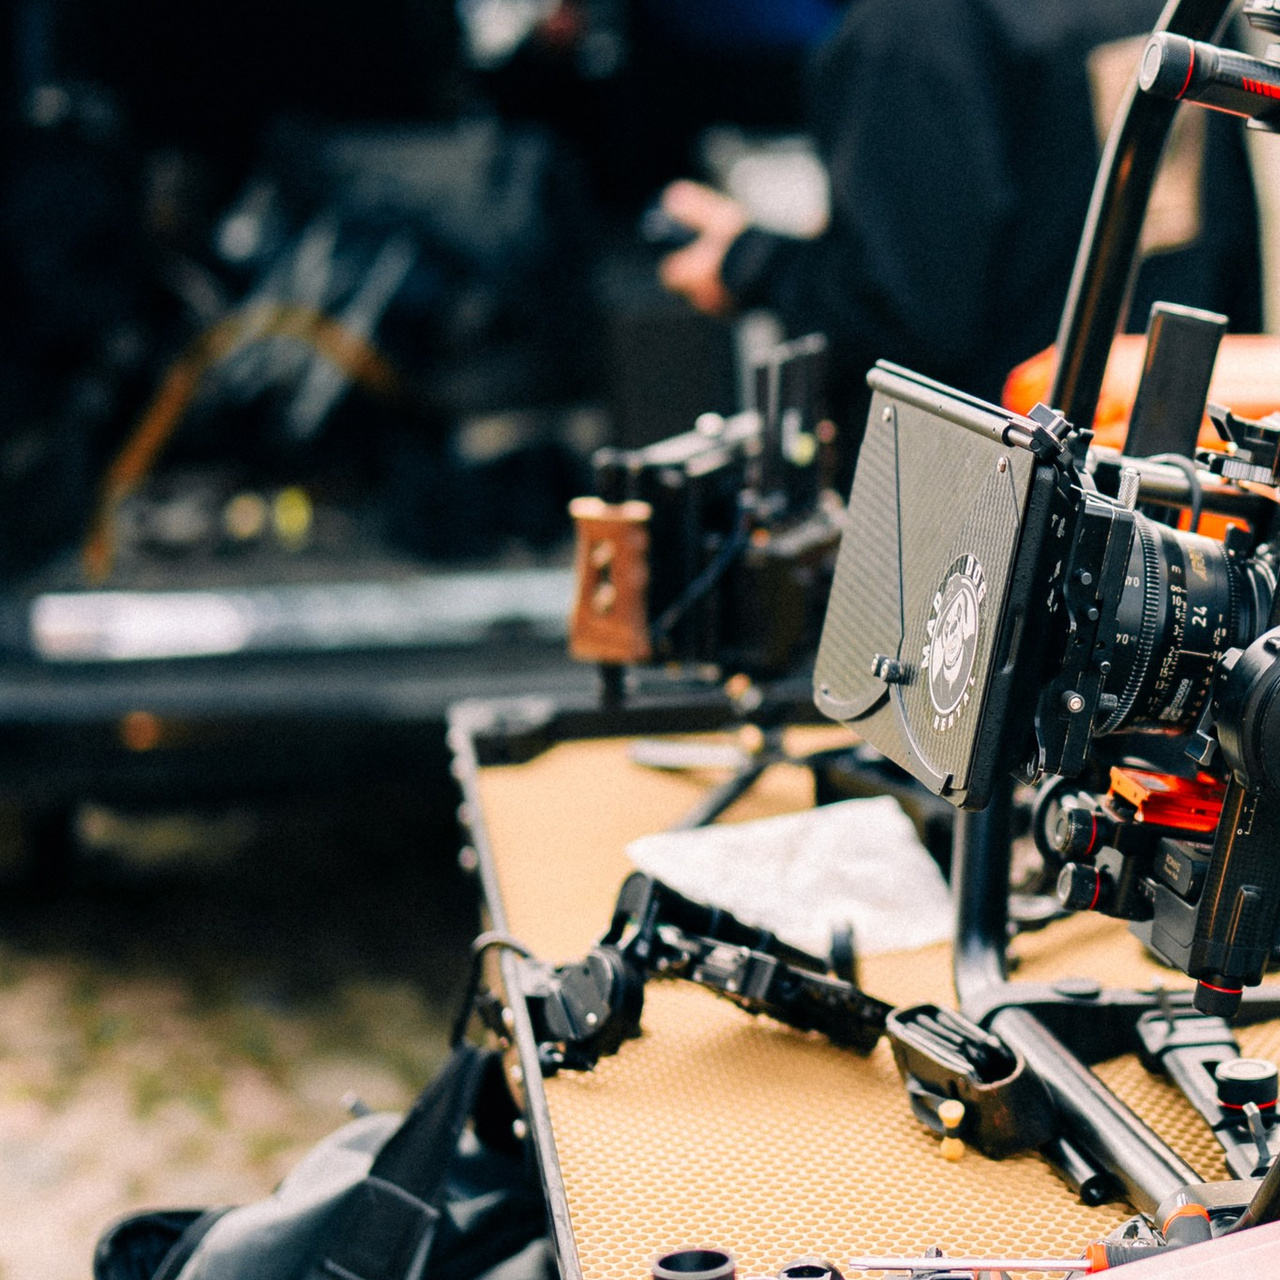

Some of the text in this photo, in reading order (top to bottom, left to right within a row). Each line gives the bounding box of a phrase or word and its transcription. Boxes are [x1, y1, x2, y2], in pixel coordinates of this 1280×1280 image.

[965, 555, 986, 604] DOG
[1172, 595, 1182, 606] 10
[1192, 606, 1208, 627] 24
[1173, 625, 1179, 635] 3
